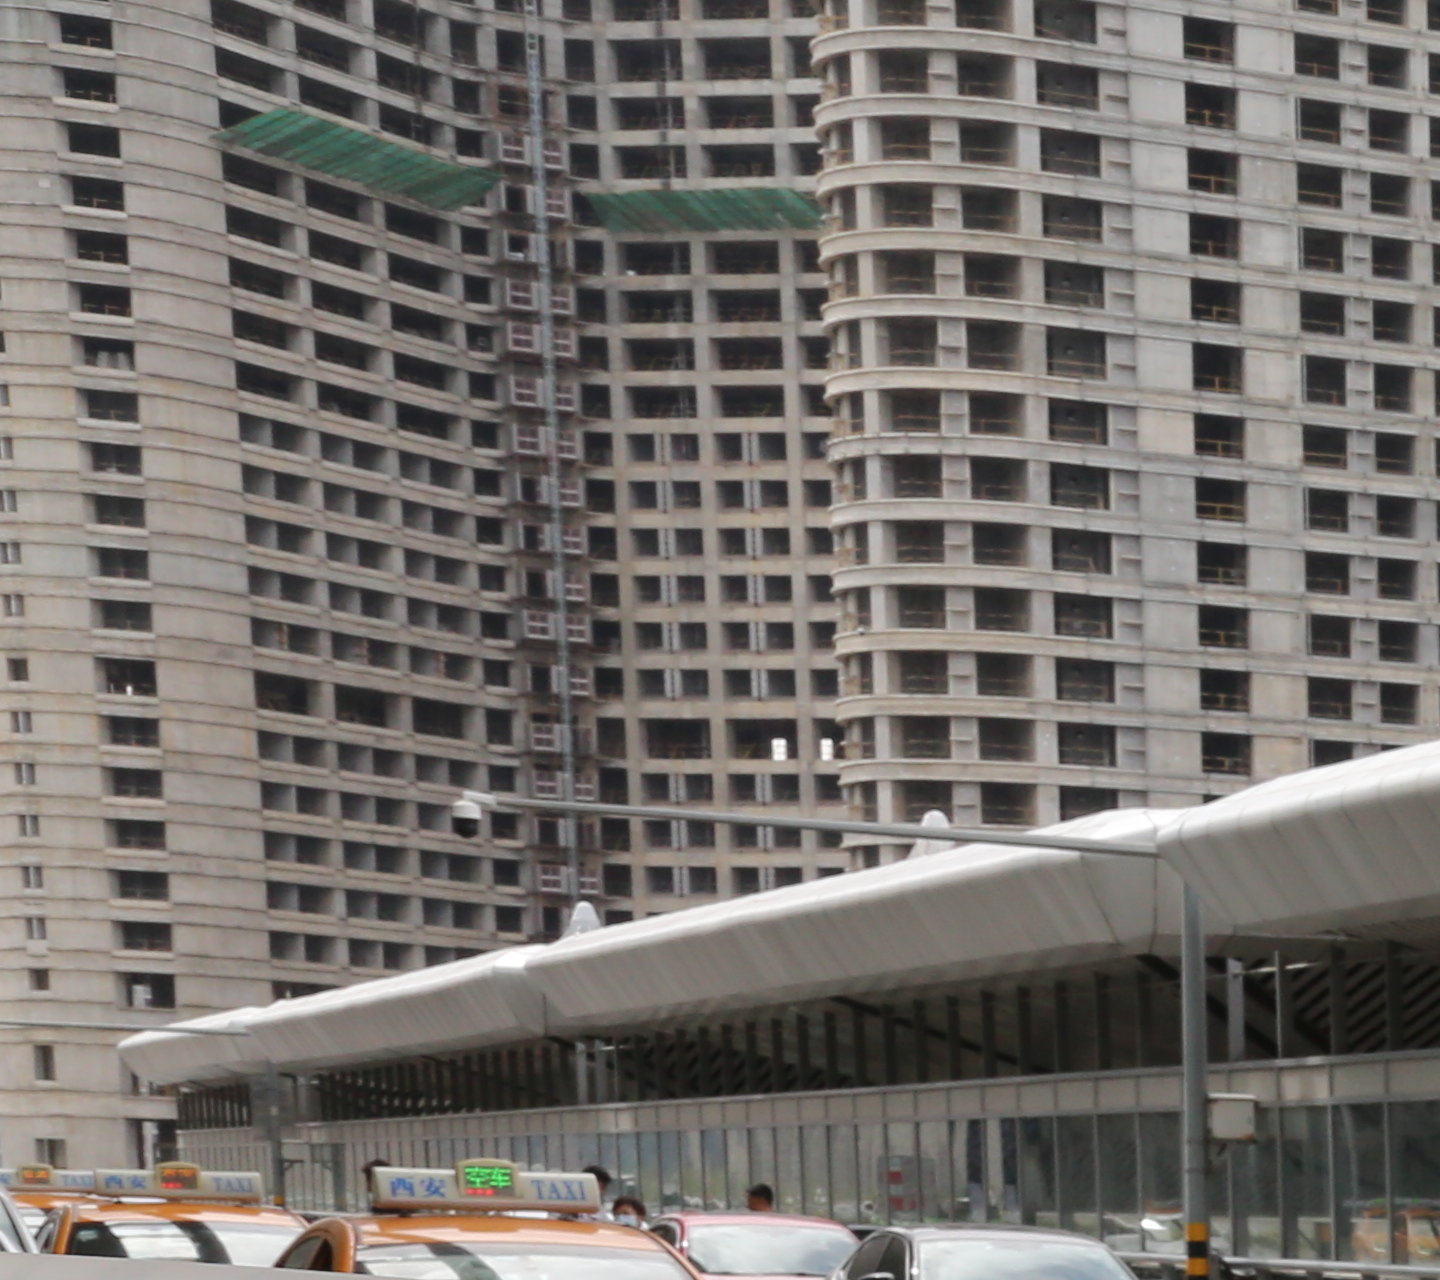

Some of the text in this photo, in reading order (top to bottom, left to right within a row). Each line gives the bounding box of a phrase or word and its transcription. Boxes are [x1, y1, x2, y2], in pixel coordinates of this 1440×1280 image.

[212, 1177, 254, 1193] TAXI
[464, 1167, 512, 1187] 空车
[390, 1177, 587, 1200] 西安 TAXI
